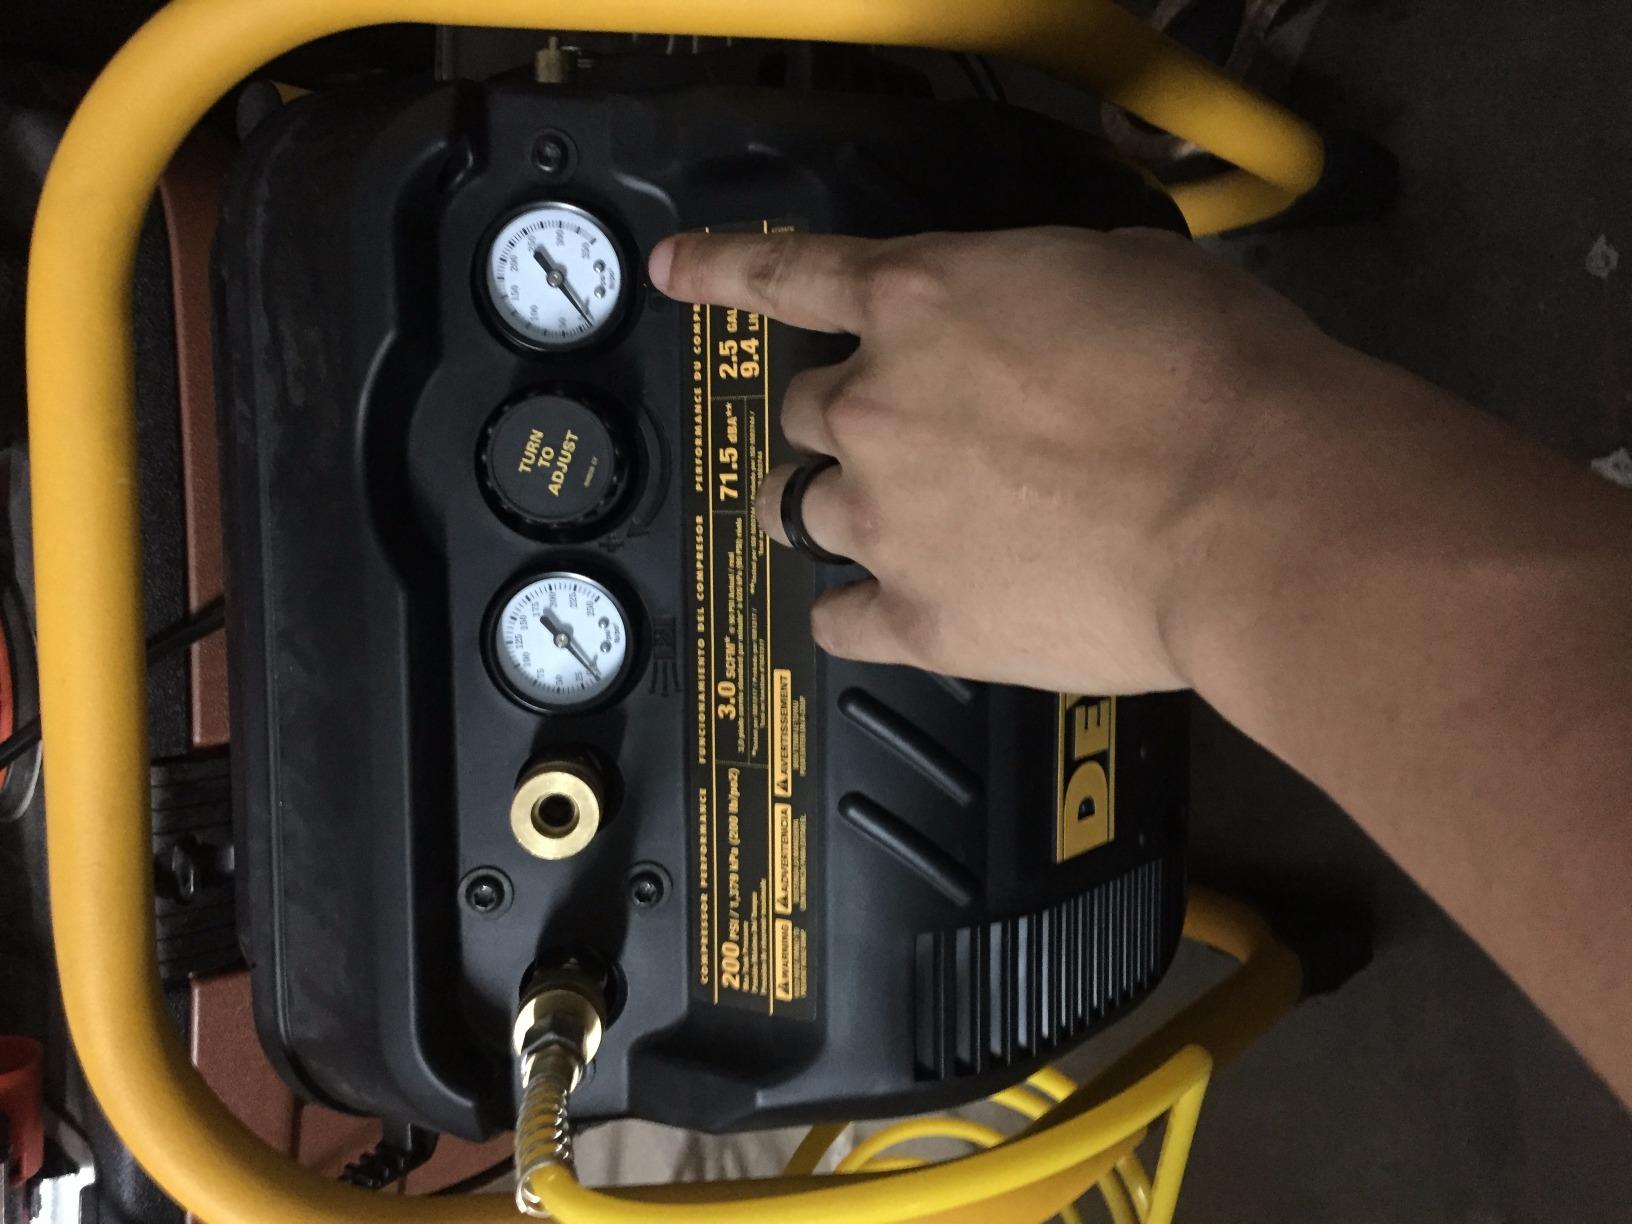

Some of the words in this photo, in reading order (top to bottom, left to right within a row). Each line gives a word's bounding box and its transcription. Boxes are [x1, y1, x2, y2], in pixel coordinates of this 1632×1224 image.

[510, 254, 519, 272] 200
[510, 284, 520, 301] 150
[692, 304, 701, 354] COMPR
[693, 360, 702, 380] DU
[719, 340, 738, 379] 2.5
[740, 338, 759, 378] 9.4
[518, 428, 544, 473] TURN
[537, 446, 555, 468] TO
[694, 387, 703, 491] PERFORMANCE
[548, 429, 579, 497] ADJUST
[719, 447, 738, 501] 71.5
[695, 515, 704, 600] COMPRESOR
[531, 601, 540, 616] 175
[568, 591, 578, 608] 225
[586, 600, 594, 616] 250
[520, 614, 528, 630] 150
[697, 607, 705, 632] DEL
[514, 633, 524, 649] 125
[522, 651, 532, 667] 100
[536, 668, 544, 679] 75
[697, 638, 706, 764] FUNCIONAMIENTO
[717, 681, 736, 720] 3.0
[779, 675, 789, 775] AVERTISSEMENT
[1063, 693, 1110, 861] DE
[699, 787, 708, 887] PERFORMANCE
[780, 808, 789, 892] ADVERTENCIA
[728, 873, 741, 908] 1,379
[699, 893, 708, 984] COMPRESSOR
[729, 919, 739, 941] PSI
[721, 941, 740, 990] 200
[780, 924, 789, 979] WARNING
